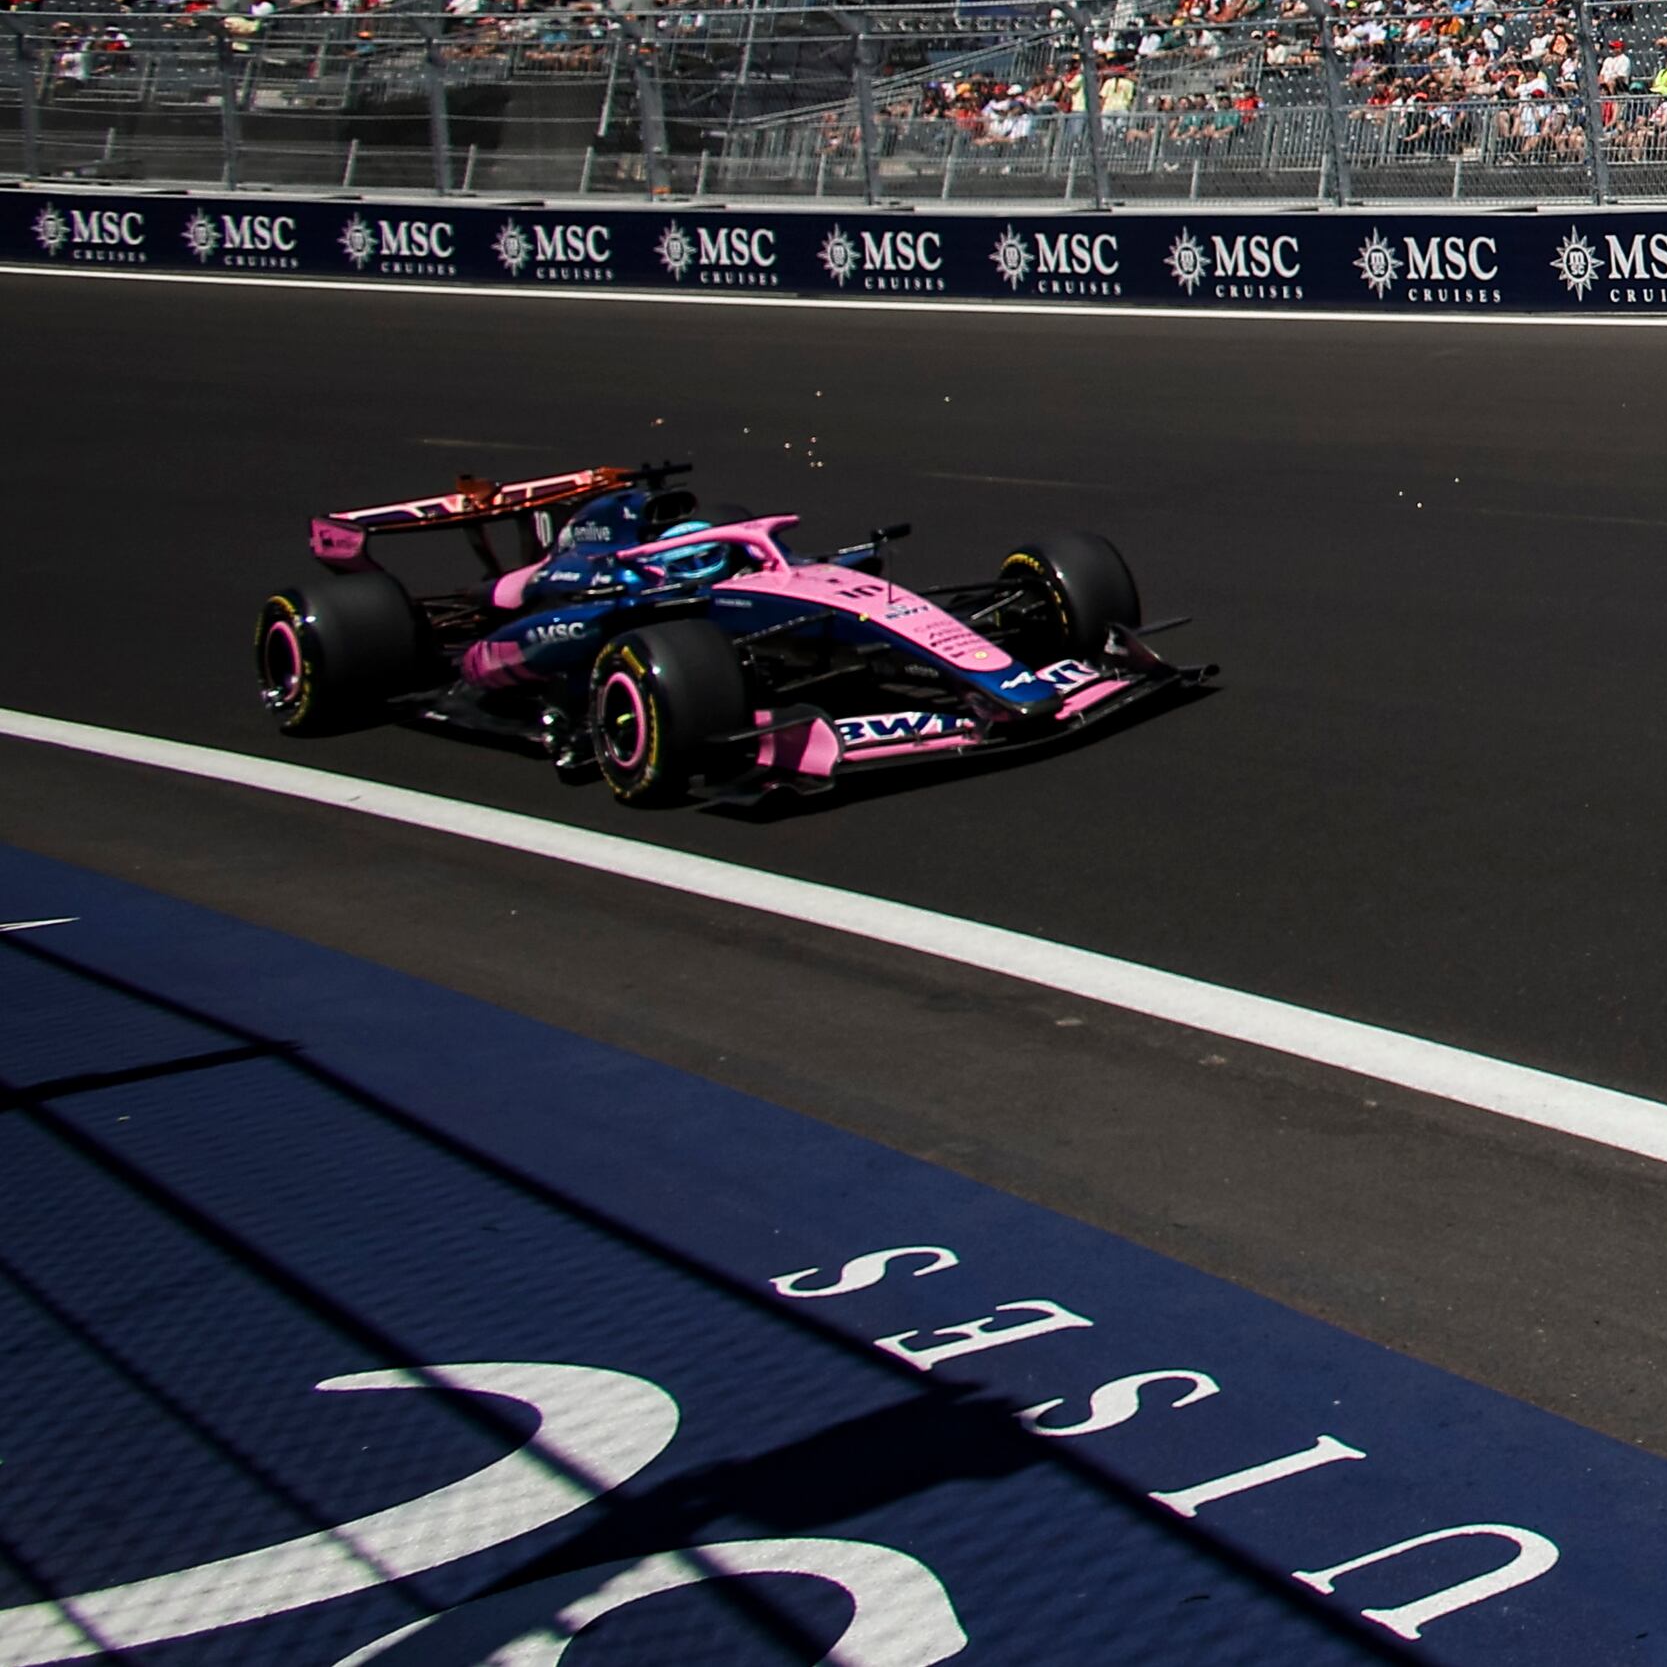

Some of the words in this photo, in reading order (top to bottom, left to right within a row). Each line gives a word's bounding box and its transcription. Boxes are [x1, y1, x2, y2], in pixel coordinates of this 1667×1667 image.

[71, 210, 144, 245] MSC
[222, 215, 295, 250] MSC
[379, 221, 453, 257] MSC
[534, 226, 610, 262] MSC
[698, 228, 776, 266] MSC
[73, 250, 147, 262] CRUISES
[861, 232, 942, 270] MSC
[1035, 234, 1119, 274] MSC
[1212, 236, 1300, 277] MSC
[1404, 237, 1498, 280] MSC
[224, 256, 299, 268] CRUISES
[381, 262, 457, 275] CRUISES
[537, 268, 613, 280] CRUISES
[701, 272, 778, 285] CRUISES
[865, 277, 945, 290] CRUISES
[1039, 281, 1122, 294] CRUISES
[1216, 285, 1303, 299] CRUISES
[1409, 289, 1501, 302] CRUISES
[537, 622, 585, 643] MSC
